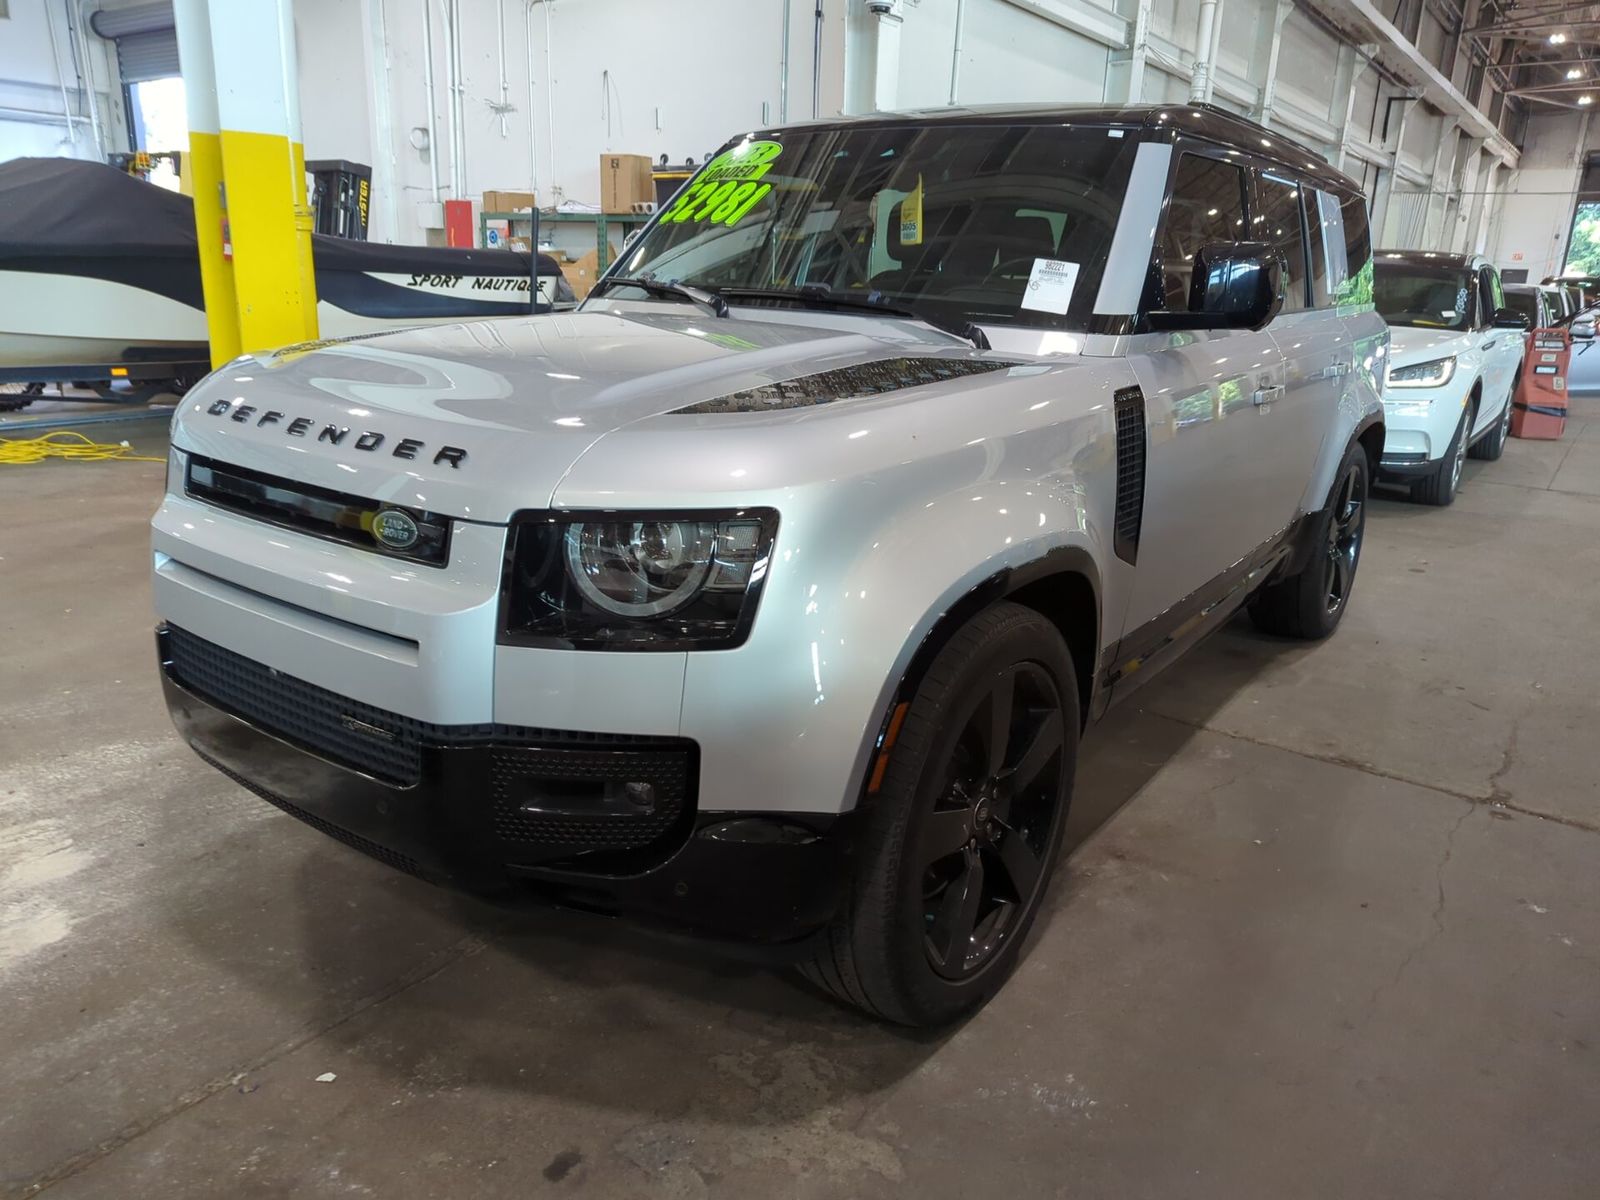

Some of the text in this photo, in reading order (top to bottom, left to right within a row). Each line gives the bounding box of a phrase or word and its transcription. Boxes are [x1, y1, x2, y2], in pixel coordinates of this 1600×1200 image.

[658, 181, 772, 226] 52981
[407, 274, 463, 288] SPORT
[207, 399, 469, 470] DEFENDER
[383, 518, 403, 529] LAND
[383, 527, 409, 540] ROVER
